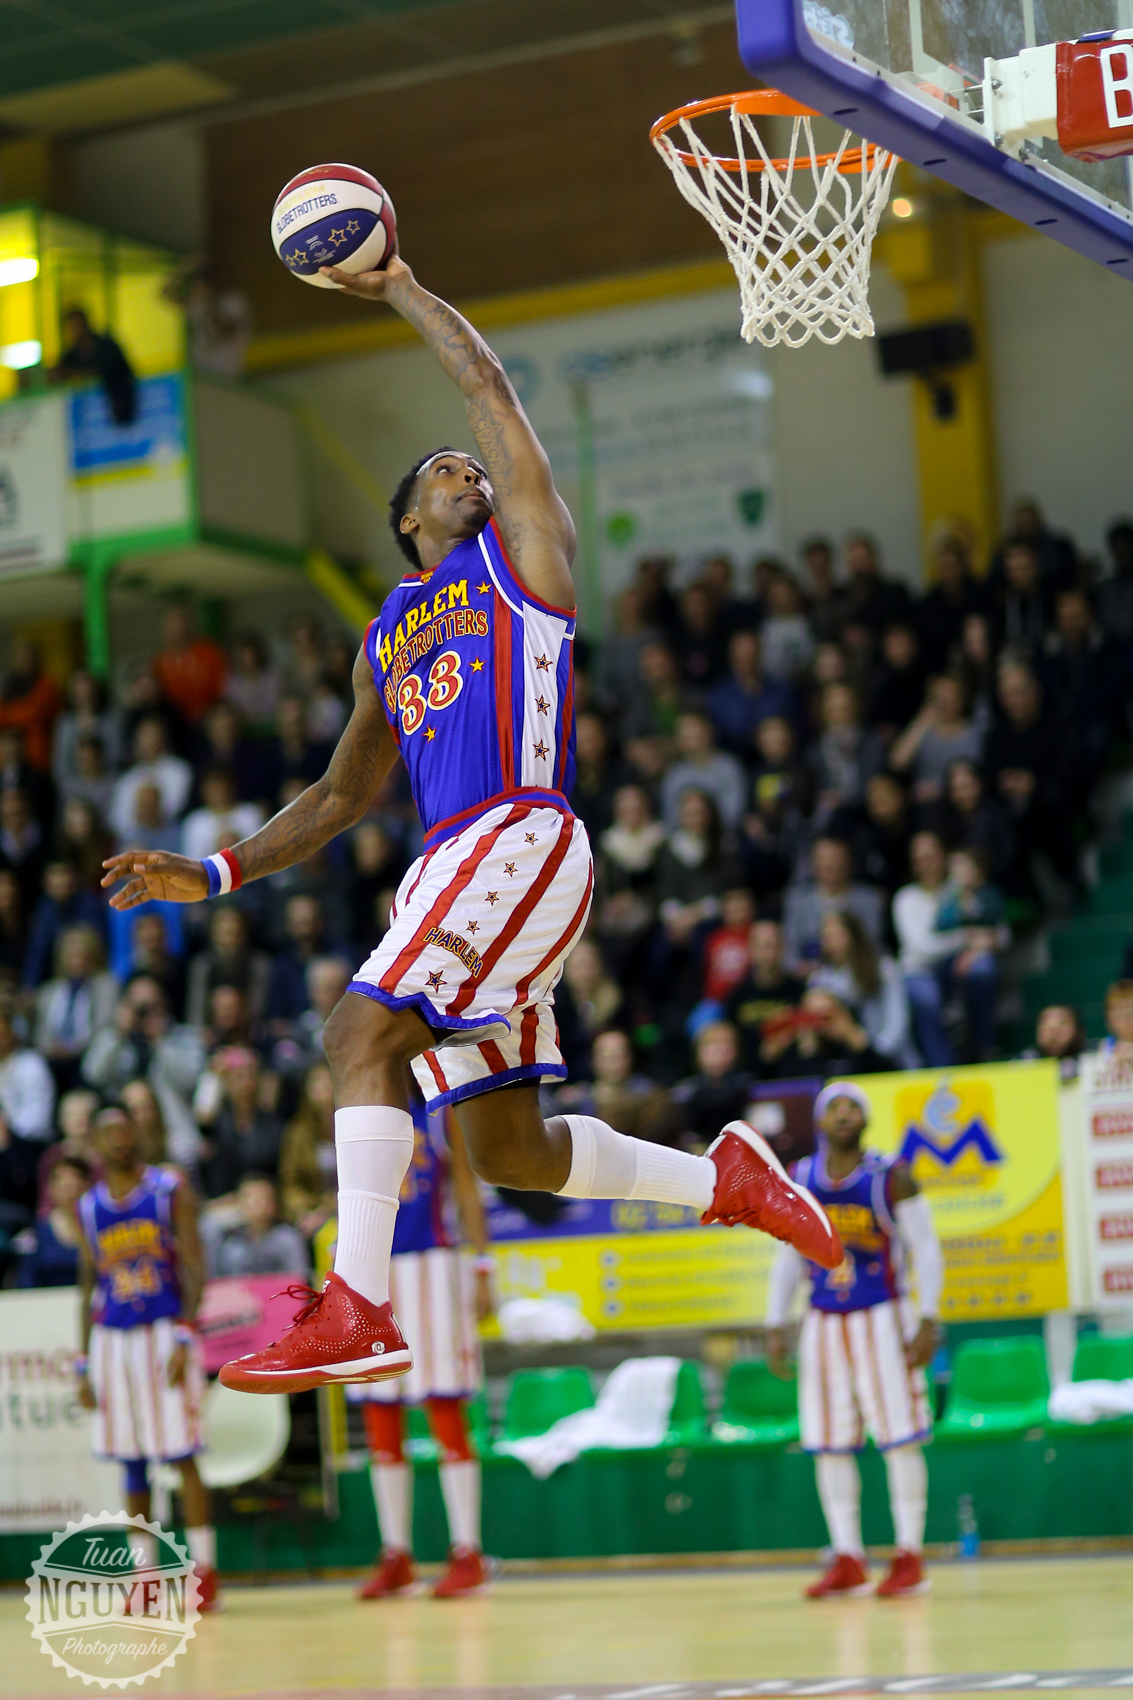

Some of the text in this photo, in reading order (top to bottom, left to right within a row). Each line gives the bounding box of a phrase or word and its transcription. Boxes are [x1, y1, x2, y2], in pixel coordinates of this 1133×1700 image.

[276, 193, 339, 234] GLOBETROTTERS
[378, 579, 470, 674] HARLEM
[383, 608, 489, 714] GLOBETROTTERS
[398, 650, 464, 736] 33
[423, 926, 484, 979] HARLEM
